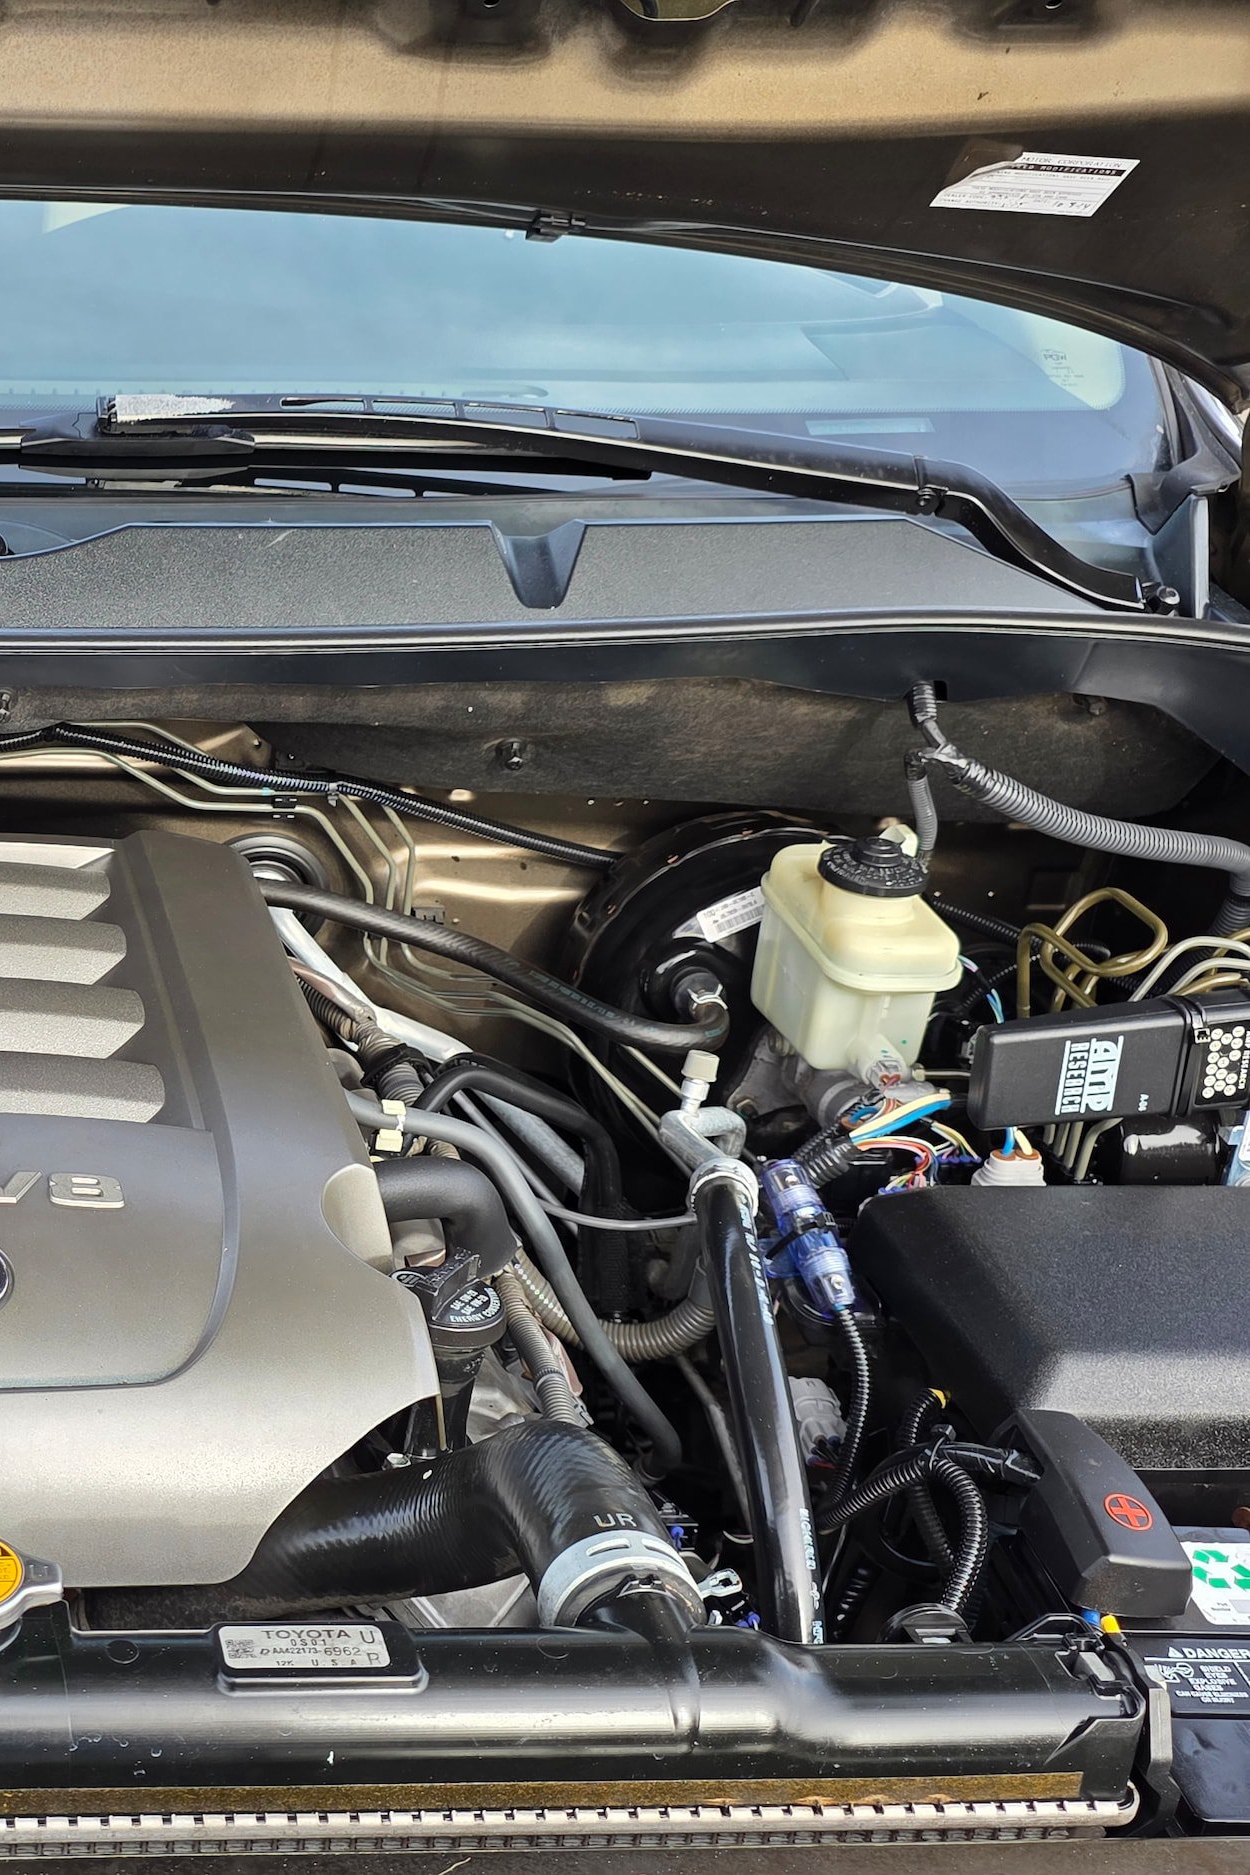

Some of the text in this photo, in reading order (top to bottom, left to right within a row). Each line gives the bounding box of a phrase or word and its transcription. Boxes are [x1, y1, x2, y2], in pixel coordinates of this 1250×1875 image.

[1058, 159, 1123, 168] CORPORATION
[1040, 165, 1118, 175] MODIFICATIONS
[1061, 1041, 1090, 1114] RESEARCH
[593, 1512, 638, 1528] UR
[260, 1629, 376, 1644] TOYOTA U
[1182, 1647, 1250, 1659] DANGER
[1187, 1677, 1237, 1686] EXPLOSIVE
